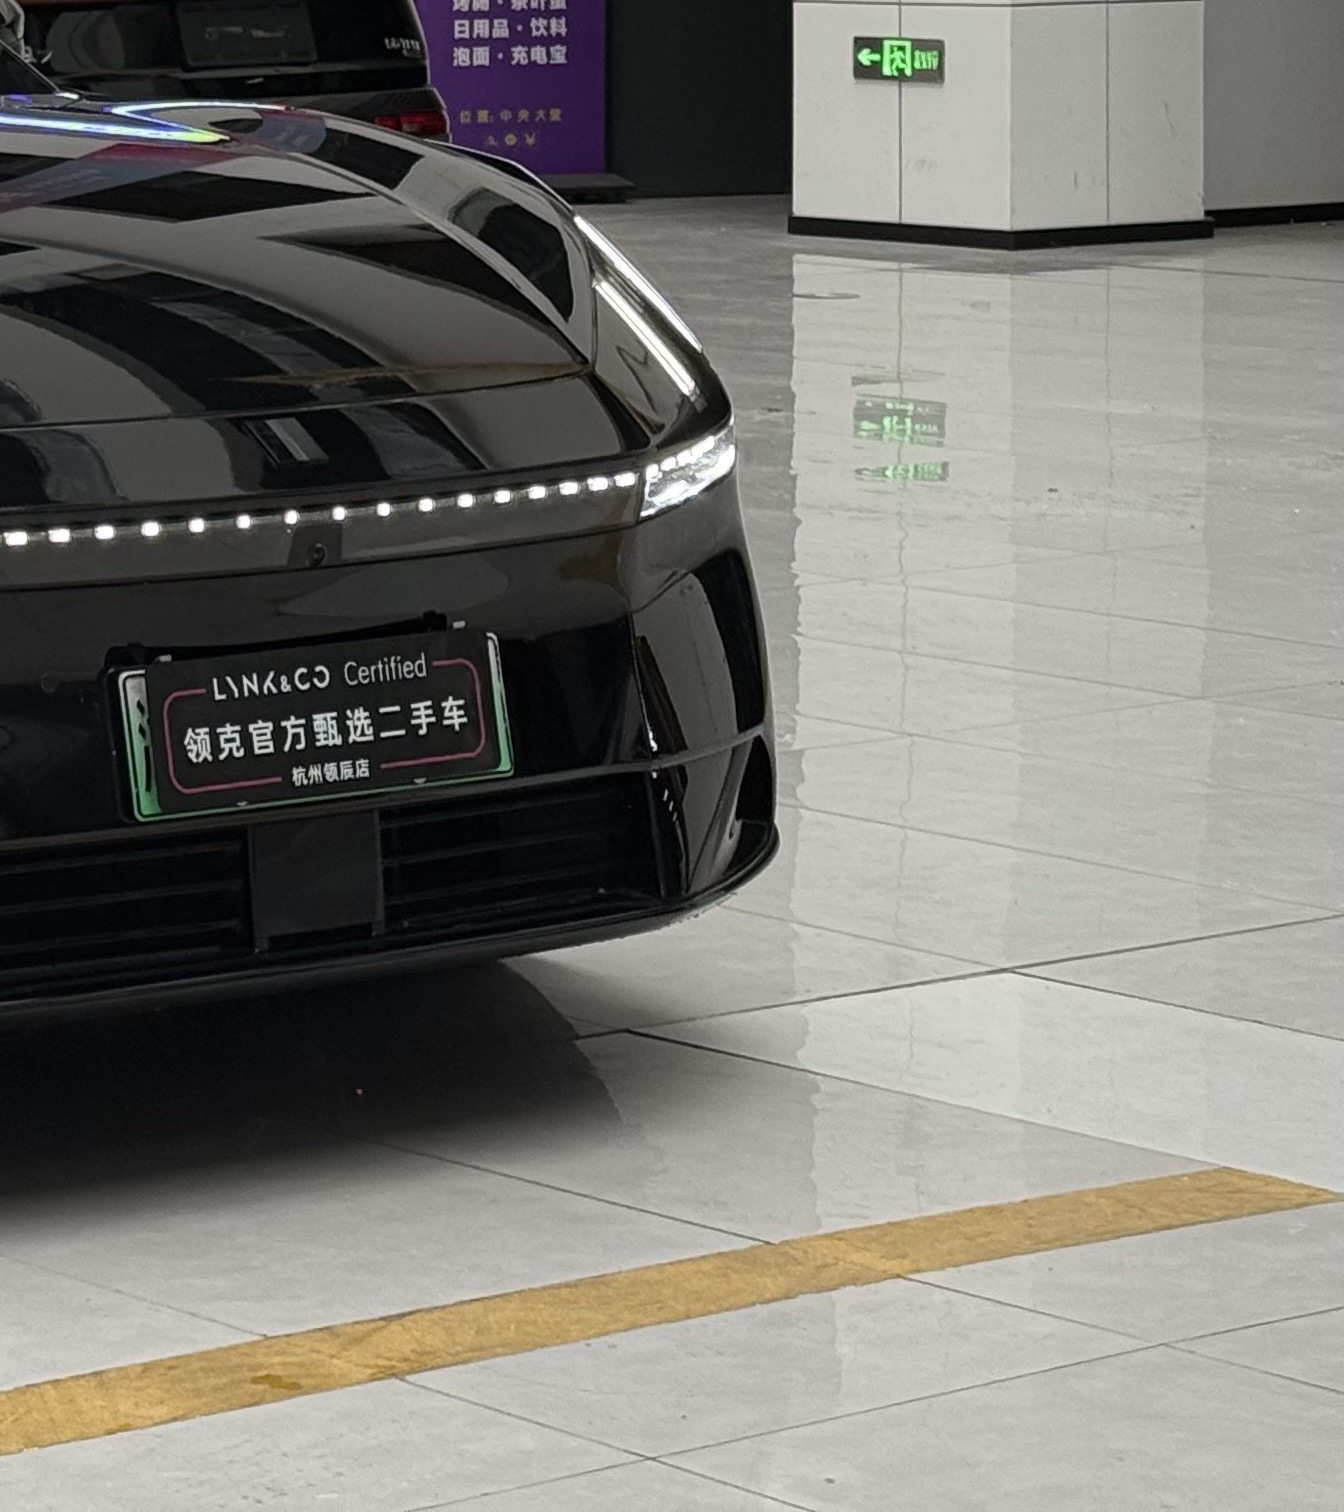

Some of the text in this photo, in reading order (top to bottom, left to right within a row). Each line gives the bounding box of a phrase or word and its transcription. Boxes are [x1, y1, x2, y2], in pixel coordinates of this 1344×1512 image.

[343, 652, 428, 687] Certified
[183, 695, 469, 765] 领克官方甄选二手车
[290, 758, 371, 788] 杭州领辰店
